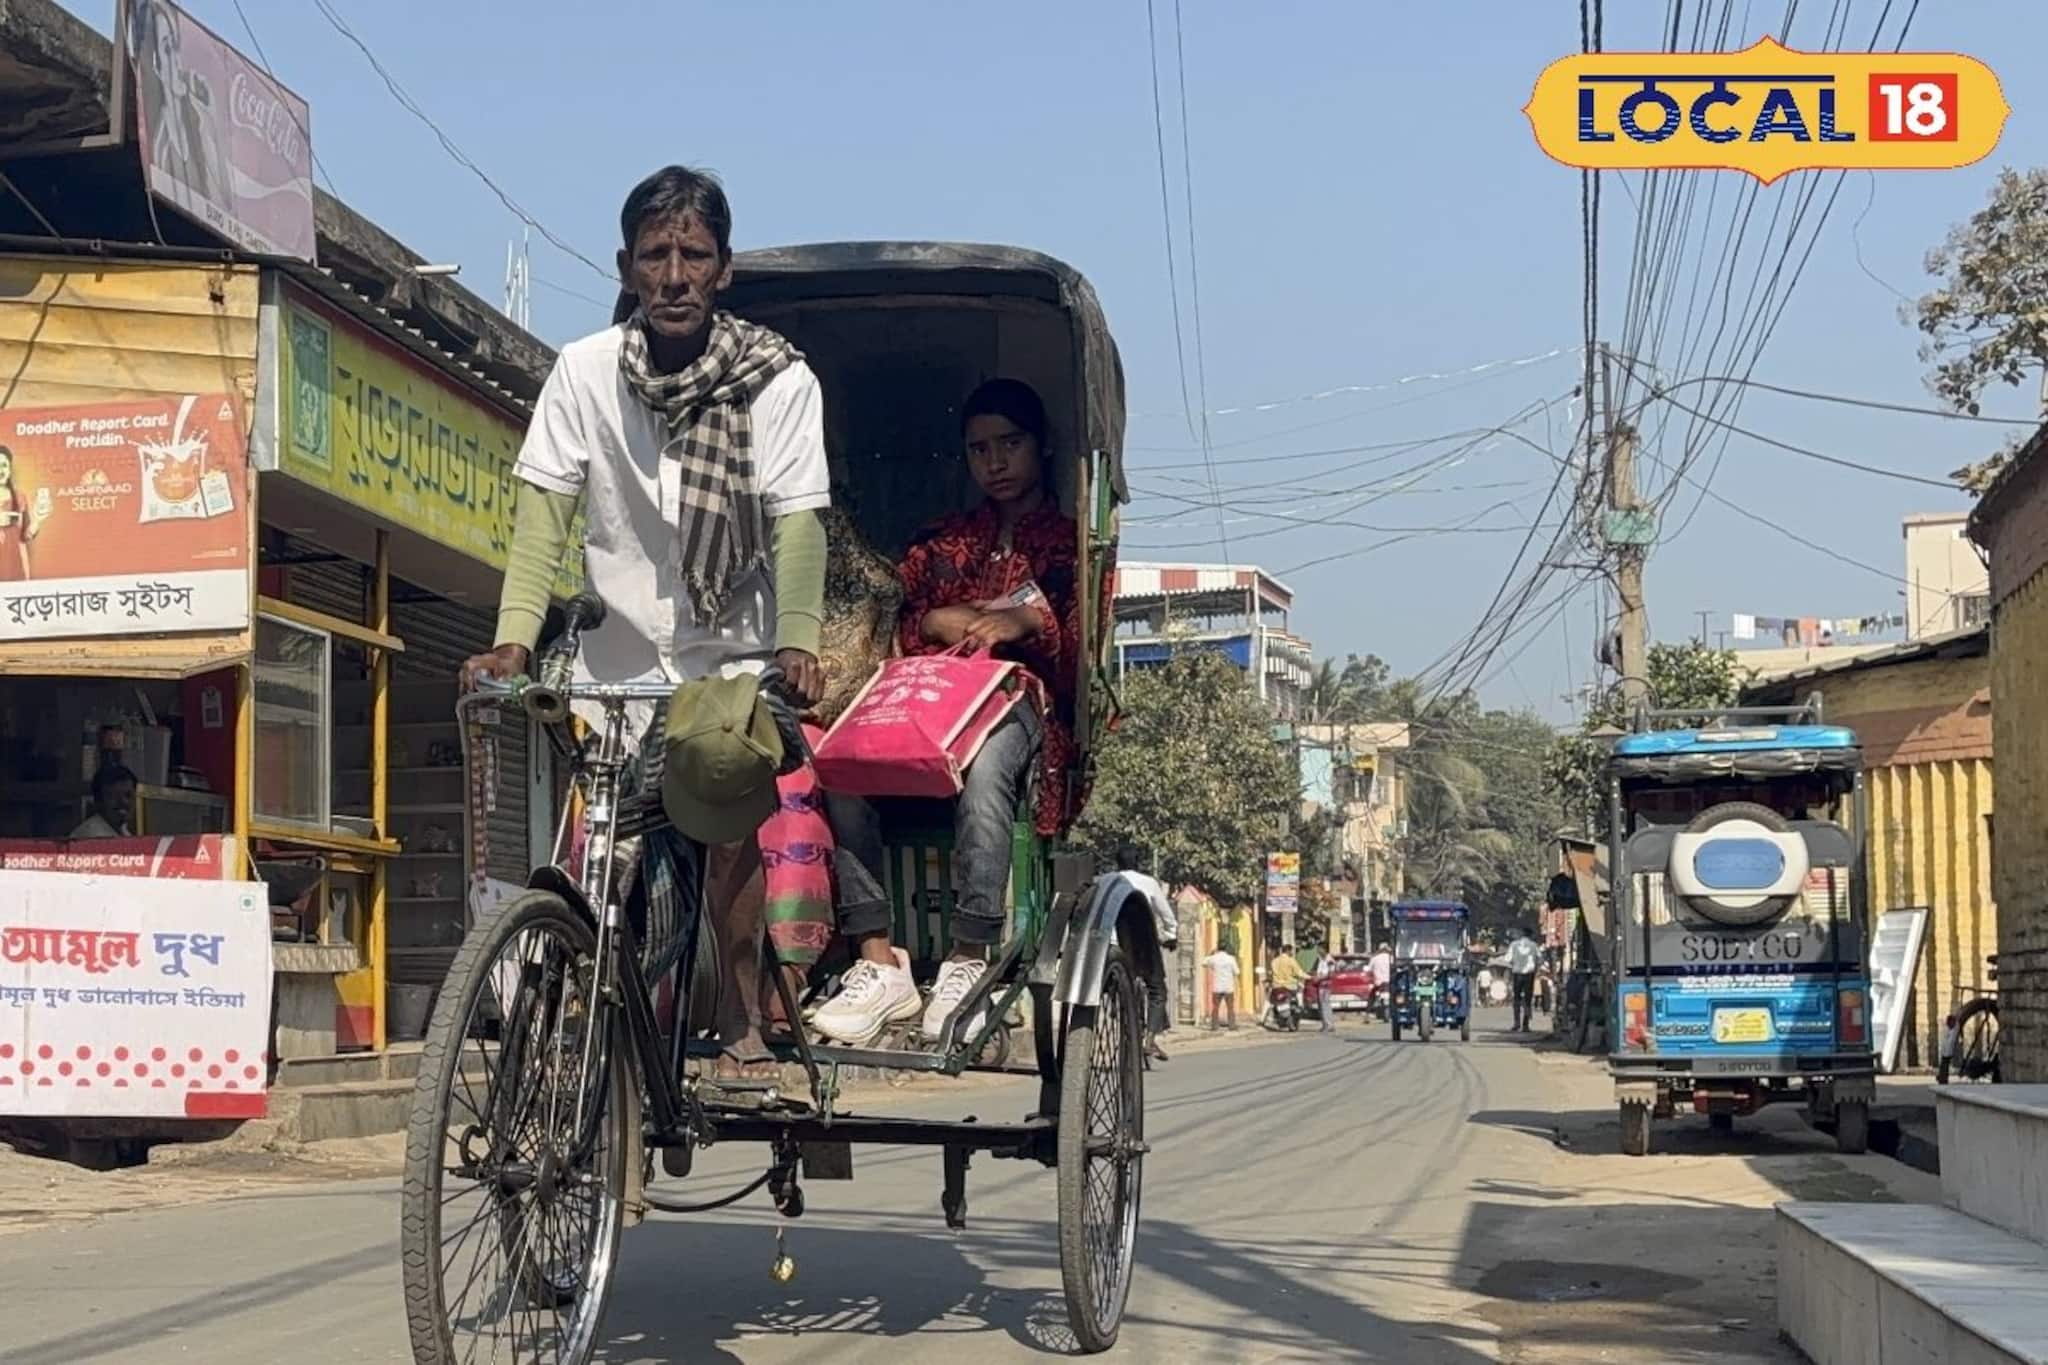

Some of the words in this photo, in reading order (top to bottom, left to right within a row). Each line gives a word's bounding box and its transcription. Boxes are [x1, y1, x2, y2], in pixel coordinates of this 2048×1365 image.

[16, 420, 76, 436] Doodher
[80, 416, 130, 434] Report
[132, 413, 169, 428] Card
[66, 433, 125, 449] Protidin
[71, 496, 118, 512] SELECT
[4, 589, 111, 625] বুড়োরাজ
[116, 581, 195, 618] সুইটস্
[1, 927, 141, 974] আমূল
[153, 933, 226, 977] দুধ
[42, 987, 72, 1008] দুধ
[77, 986, 178, 1006] ভালোবাসে
[184, 986, 246, 1009] ইন্ডিয়া
